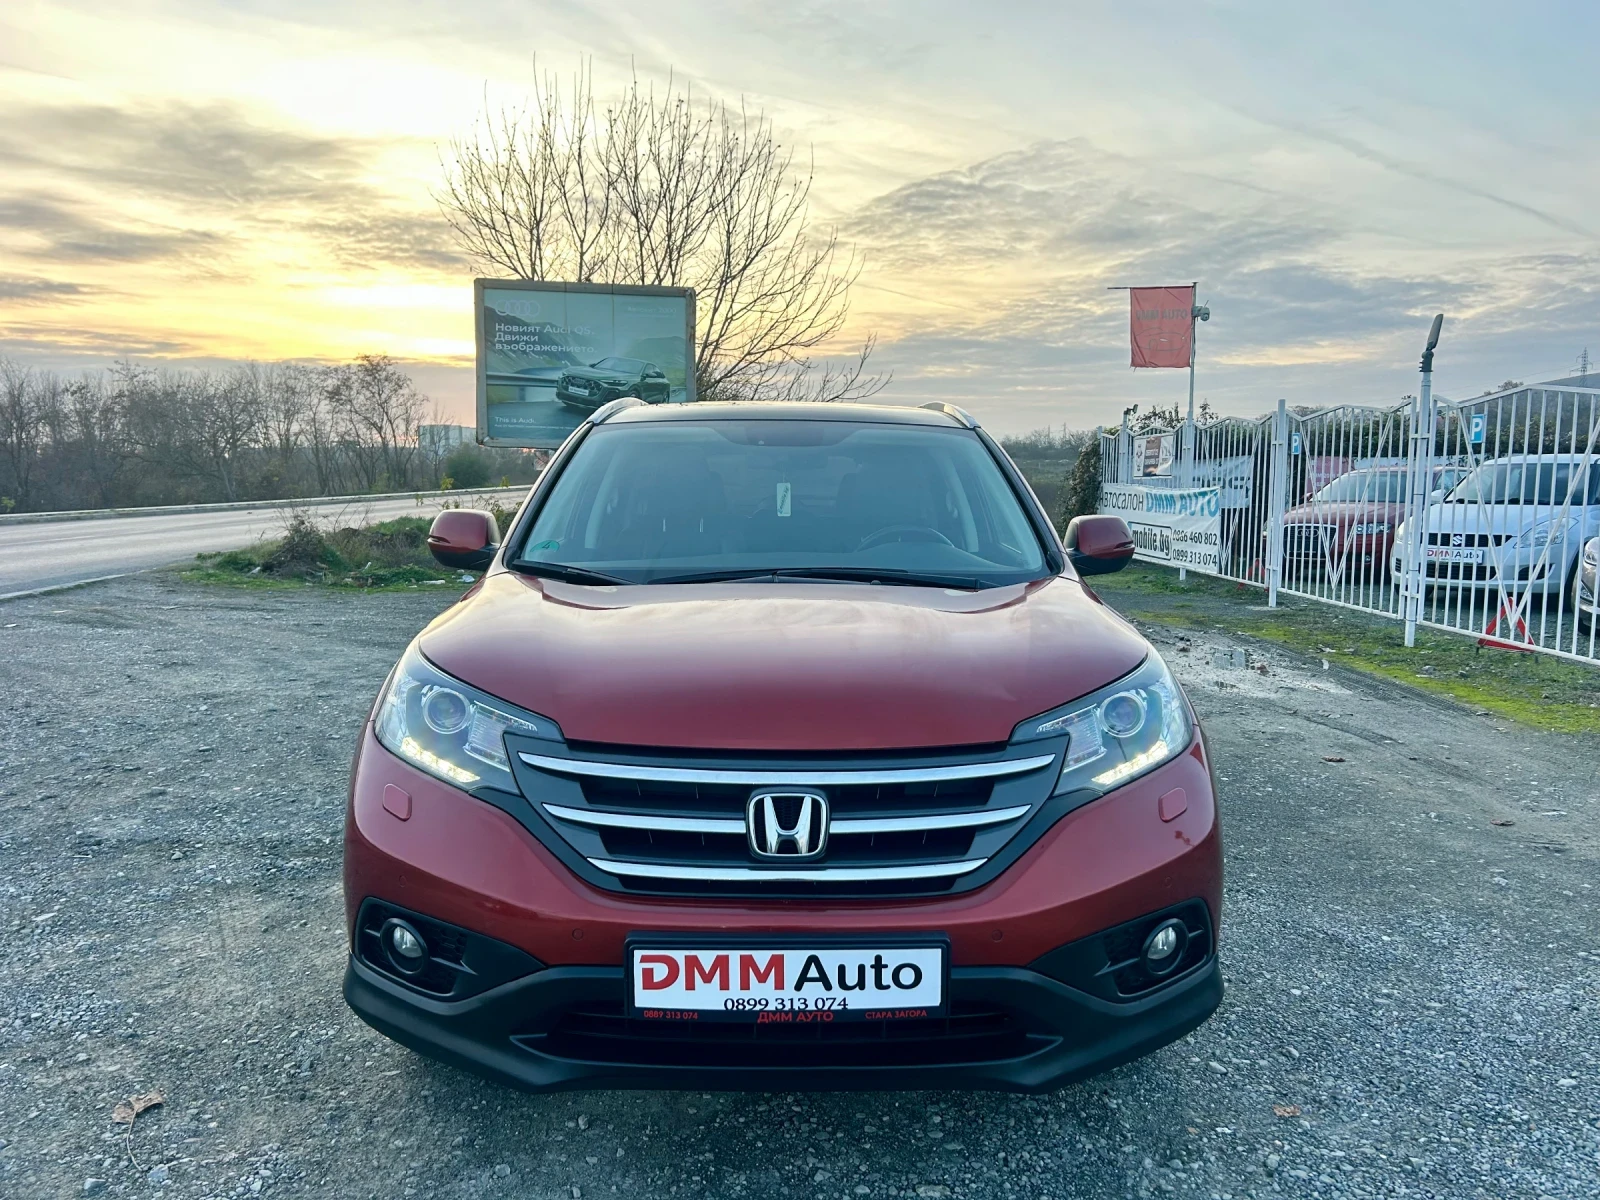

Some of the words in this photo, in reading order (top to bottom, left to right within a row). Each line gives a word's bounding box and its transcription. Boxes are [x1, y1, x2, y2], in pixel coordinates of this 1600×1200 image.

[1161, 308, 1188, 320] AUTO
[495, 323, 540, 333] Новият
[544, 325, 571, 334] Audi
[495, 332, 539, 342] Движи
[495, 342, 598, 353] въображението.
[1471, 417, 1483, 440] P
[1292, 436, 1299, 452] P
[1098, 487, 1144, 511] Автосалон
[1146, 491, 1177, 514] DMM
[1179, 489, 1220, 517] AUTO
[1132, 527, 1170, 557] mobile.bg
[1172, 529, 1188, 543] 0886
[1189, 531, 1203, 544] 460
[1204, 532, 1218, 545] 802
[1172, 549, 1188, 561] 0899
[1189, 551, 1202, 563] 313
[1203, 553, 1218, 567] 074
[723, 997, 769, 1011] 0899
[774, 997, 809, 1011] 313
[814, 997, 849, 1010] 074
[643, 1010, 663, 1019] 0889
[665, 1010, 679, 1019] 313
[681, 1011, 698, 1020] 074
[757, 1012, 793, 1023] ДММ
[796, 1011, 834, 1022] АУТО
[865, 1011, 893, 1020] СТАРА
[894, 1010, 927, 1018] ЗАГОРА
